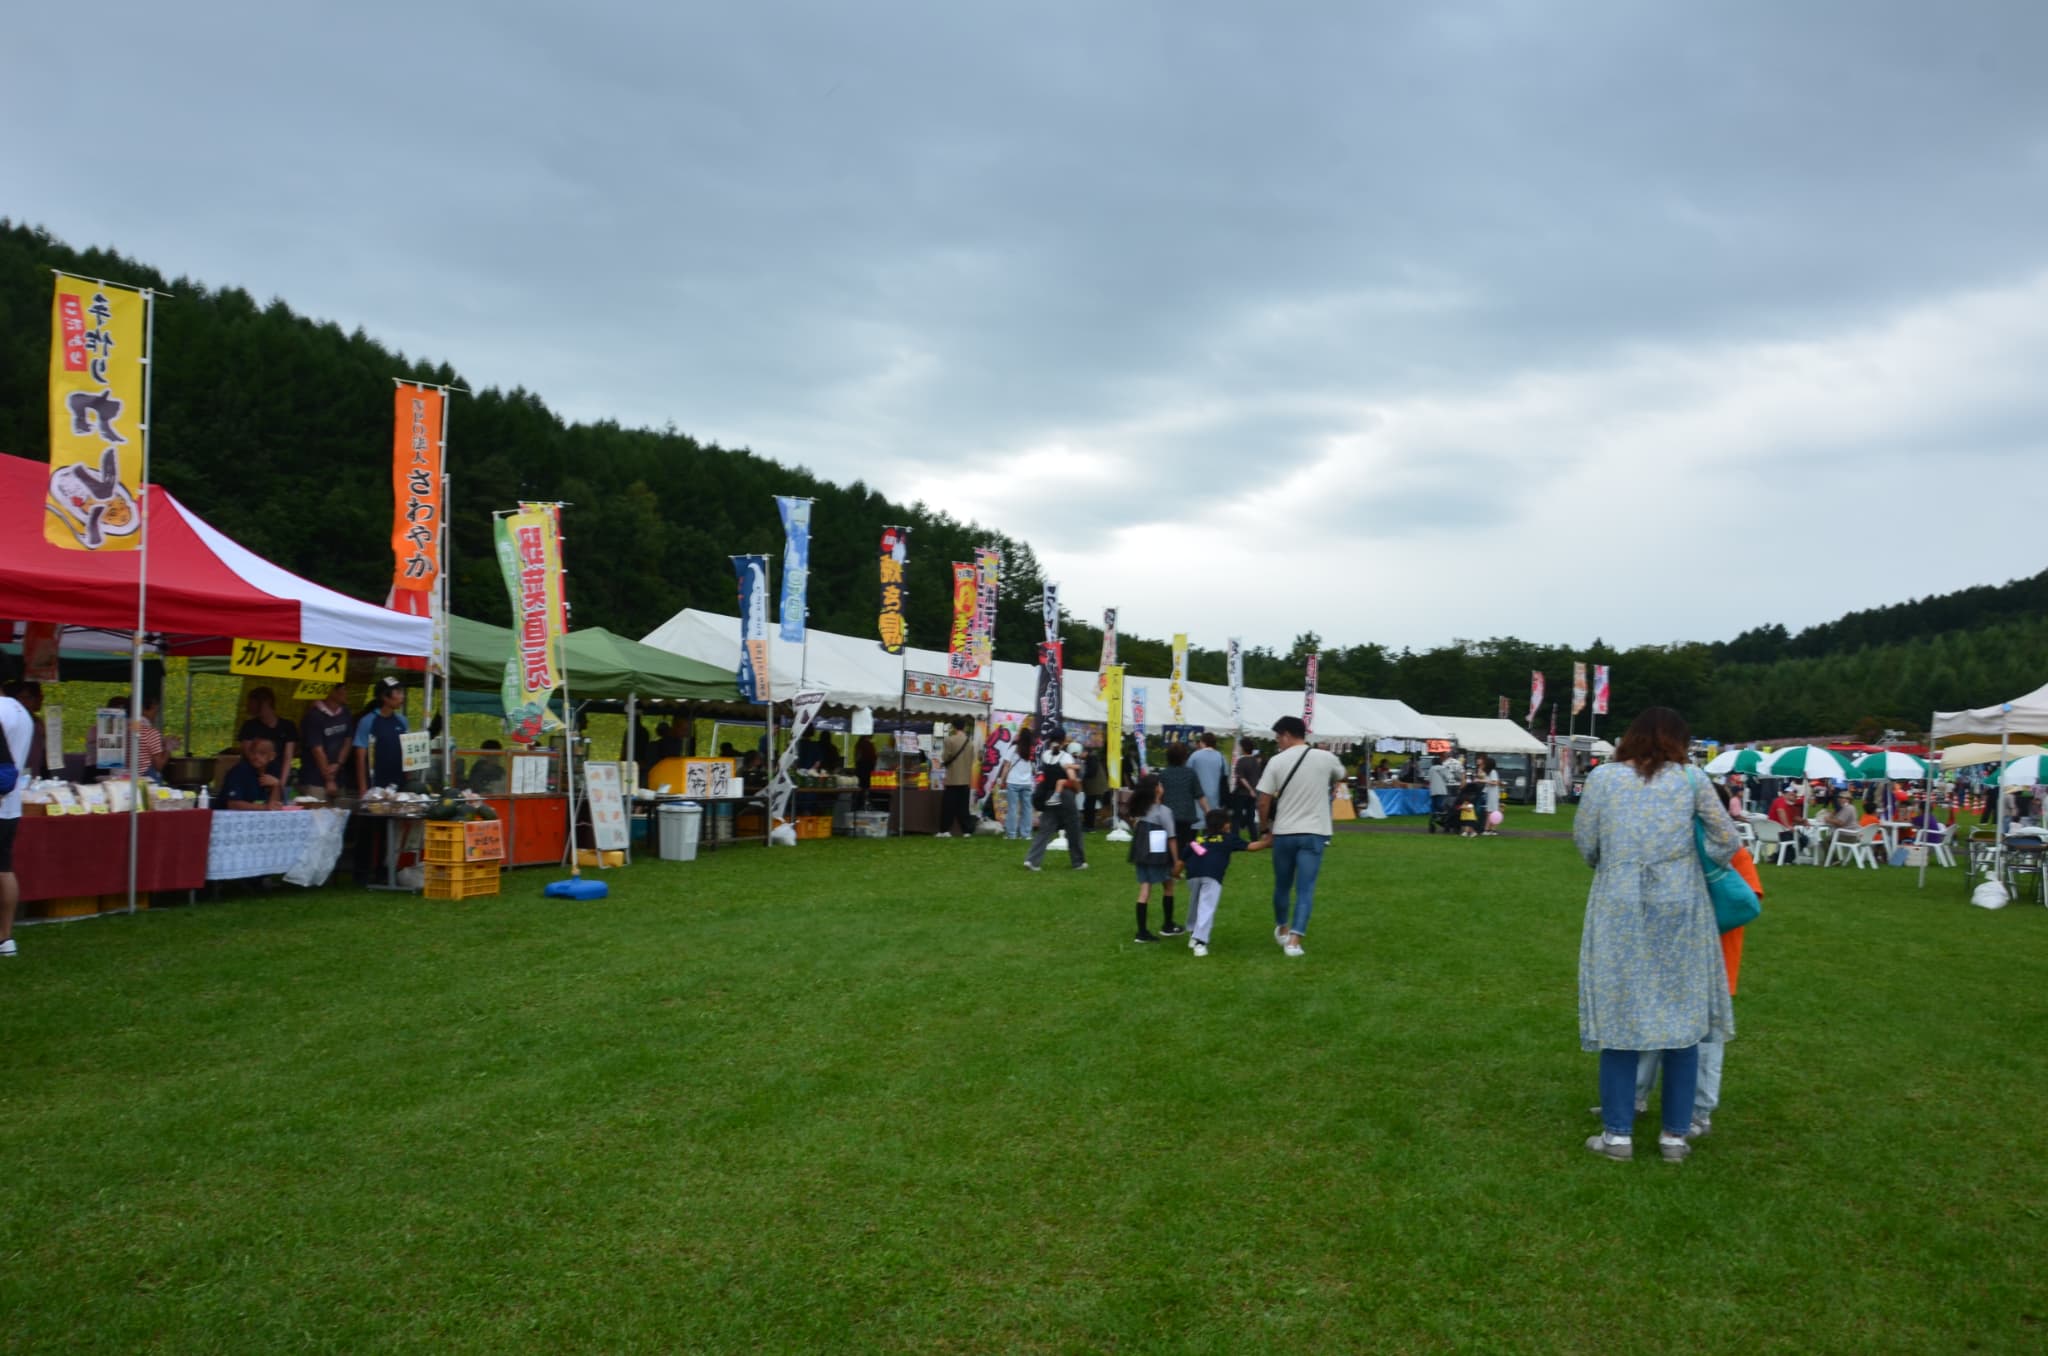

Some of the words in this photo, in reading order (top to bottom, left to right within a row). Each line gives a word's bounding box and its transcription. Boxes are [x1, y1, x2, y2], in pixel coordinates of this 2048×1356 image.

[405, 469, 434, 578] さわやか
[236, 641, 342, 673] カレーライス
